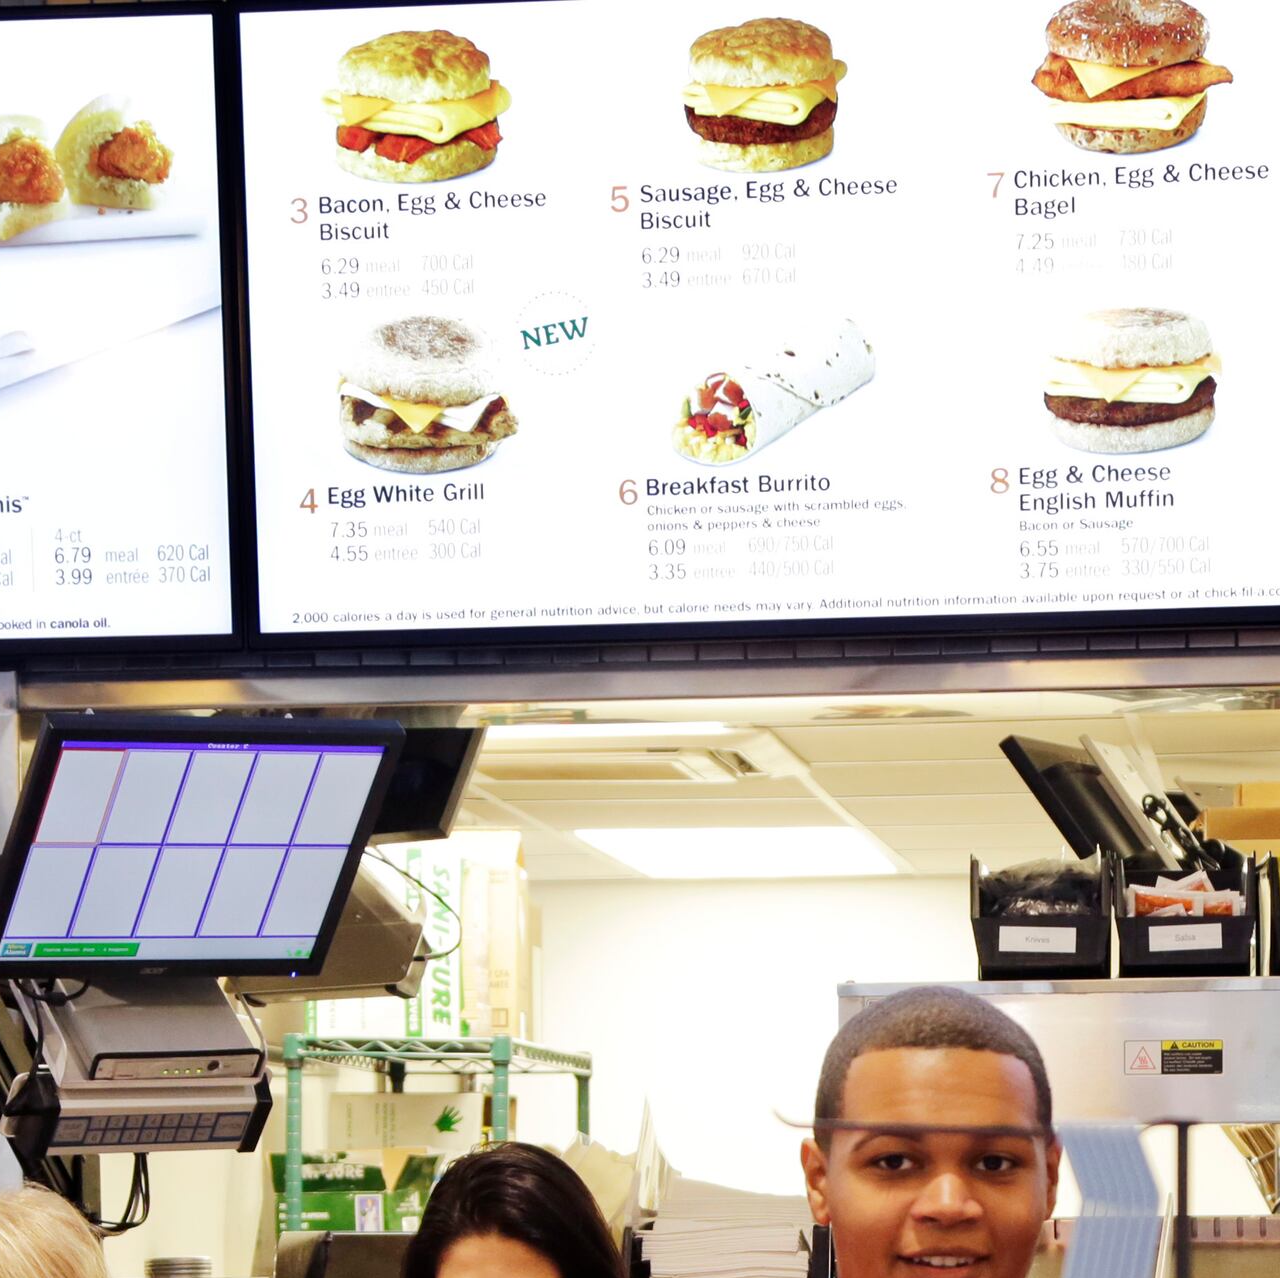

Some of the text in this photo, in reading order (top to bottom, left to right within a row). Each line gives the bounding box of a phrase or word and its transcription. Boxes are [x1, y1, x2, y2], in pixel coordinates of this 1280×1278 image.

[987, 164, 1268, 198] 7 Chicken, Egg & Cheese
[611, 178, 897, 212] 5 Sausage, Egg & Cheese
[291, 191, 546, 224] 3 Bacon, Egg & Cheese
[1015, 197, 1075, 219] Bagel
[641, 211, 710, 229] Biscuit
[320, 222, 389, 240] Biscuit
[642, 247, 679, 264] 6.29
[322, 258, 359, 275] 6.29
[643, 271, 680, 288] 3.49
[322, 282, 360, 299] 3.49
[520, 317, 588, 350] NEW
[990, 465, 1170, 494] 8 Egg & Cheese
[300, 483, 483, 514] 4 Egg White Grill
[619, 475, 830, 505] 6 Breakfast Burrito
[1020, 490, 1173, 515] English Muffin
[332, 522, 367, 538] 7.35
[55, 544, 209, 564] 6.79 620 Cal
[331, 545, 368, 561] 4.55
[649, 539, 685, 556] 6.09
[1020, 540, 1058, 557] 6.55
[56, 566, 210, 585] 3.99 370 Cal
[649, 564, 686, 580] 3.35
[50, 618, 110, 629] canola oil.
[431, 866, 451, 1025] SANI-URE
[1025, 936, 1050, 944] Knives
[1175, 933, 1196, 943] Salsa
[1182, 1041, 1215, 1049] CAUTION
